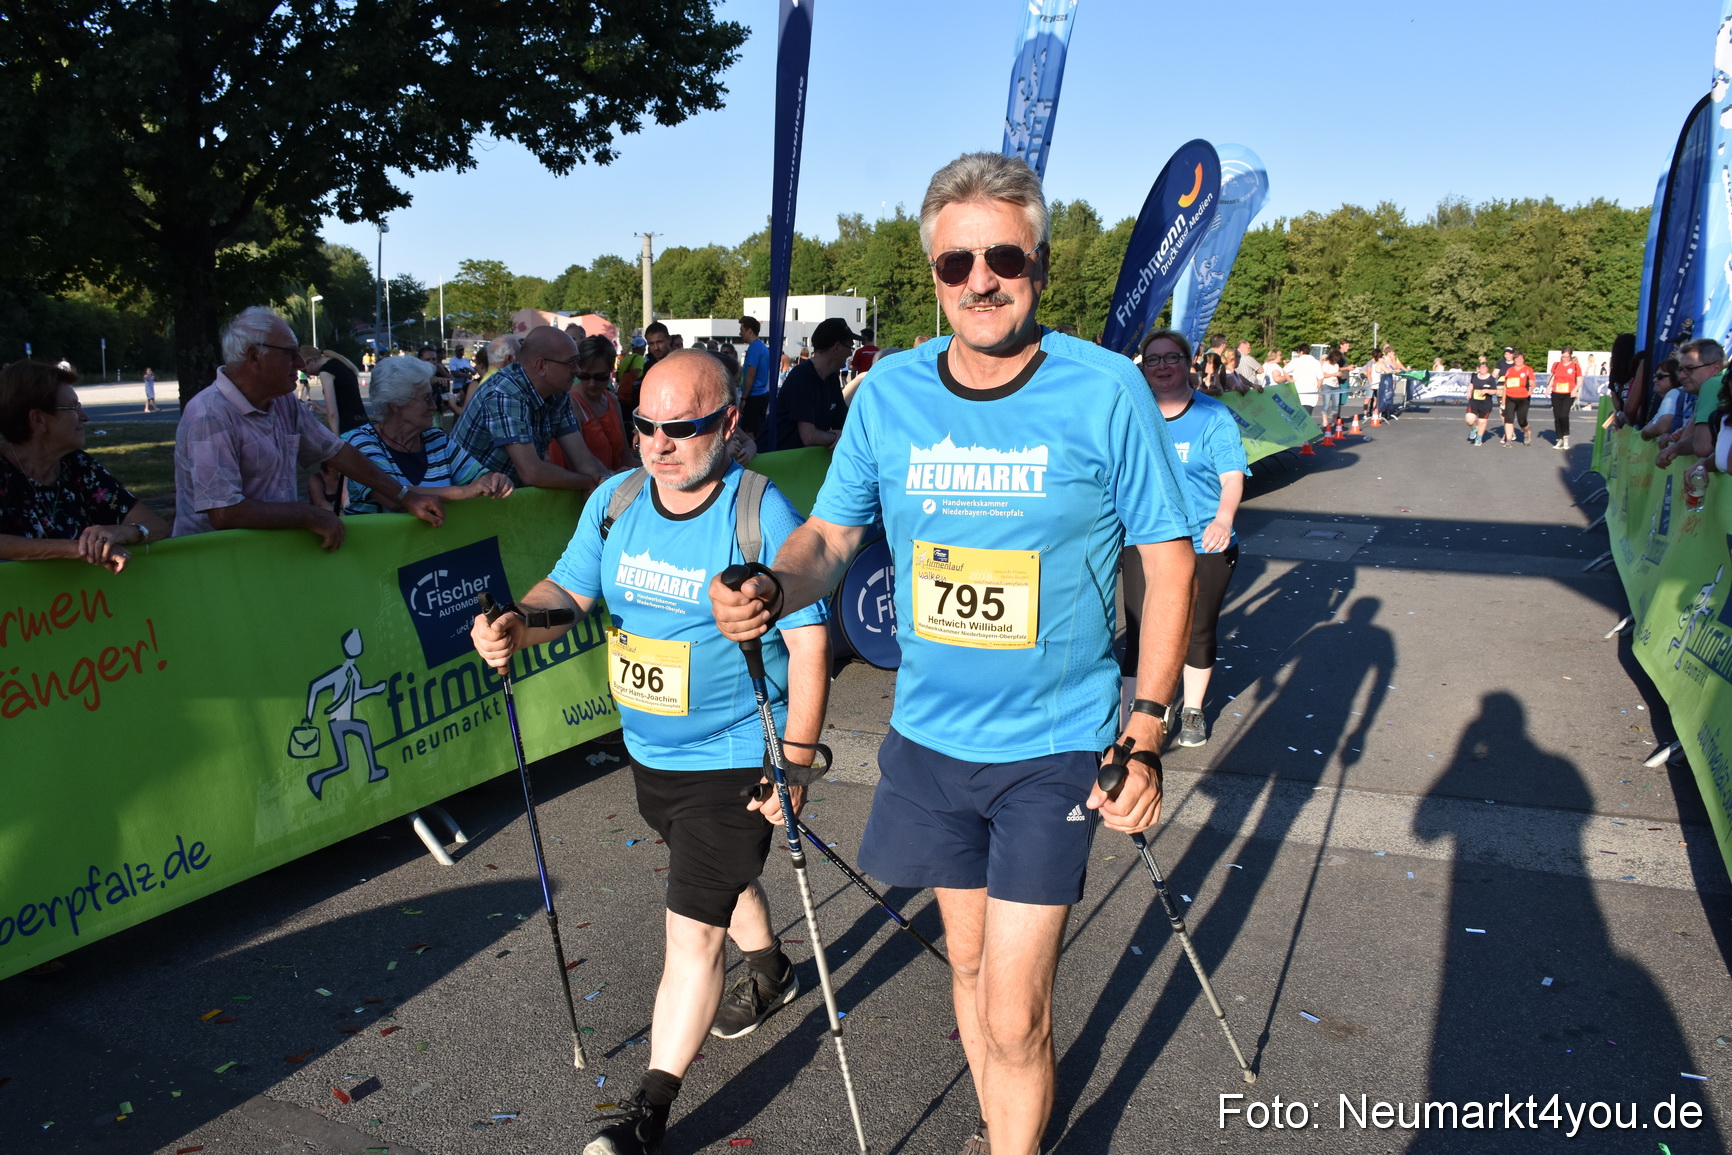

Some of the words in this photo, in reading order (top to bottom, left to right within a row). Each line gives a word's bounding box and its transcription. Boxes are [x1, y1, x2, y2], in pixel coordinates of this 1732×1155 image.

[1160, 247, 1179, 276] Druck
[1176, 229, 1189, 249] und
[1189, 193, 1214, 230] Medien
[1116, 213, 1187, 328] Frischmann
[906, 464, 1047, 492] NEUMARKT
[942, 498, 1009, 508] Handwerkskammer
[942, 507, 1024, 518] Niederbayern-Oberpfalz
[926, 558, 965, 572] firmenlauf
[426, 574, 491, 610] Fischer
[616, 564, 704, 600] NEUMARKT
[439, 596, 479, 618] AUTOMOB
[934, 581, 1006, 622] 795
[928, 615, 966, 630] Hertwich
[969, 621, 1013, 633] Willibald
[961, 631, 1027, 640] Niederbayern-Oberpfalz
[0, 619, 167, 719] änger!
[620, 657, 664, 693] 796
[628, 688, 678, 703] Hans-Joachim
[402, 697, 502, 764] neumarkt
